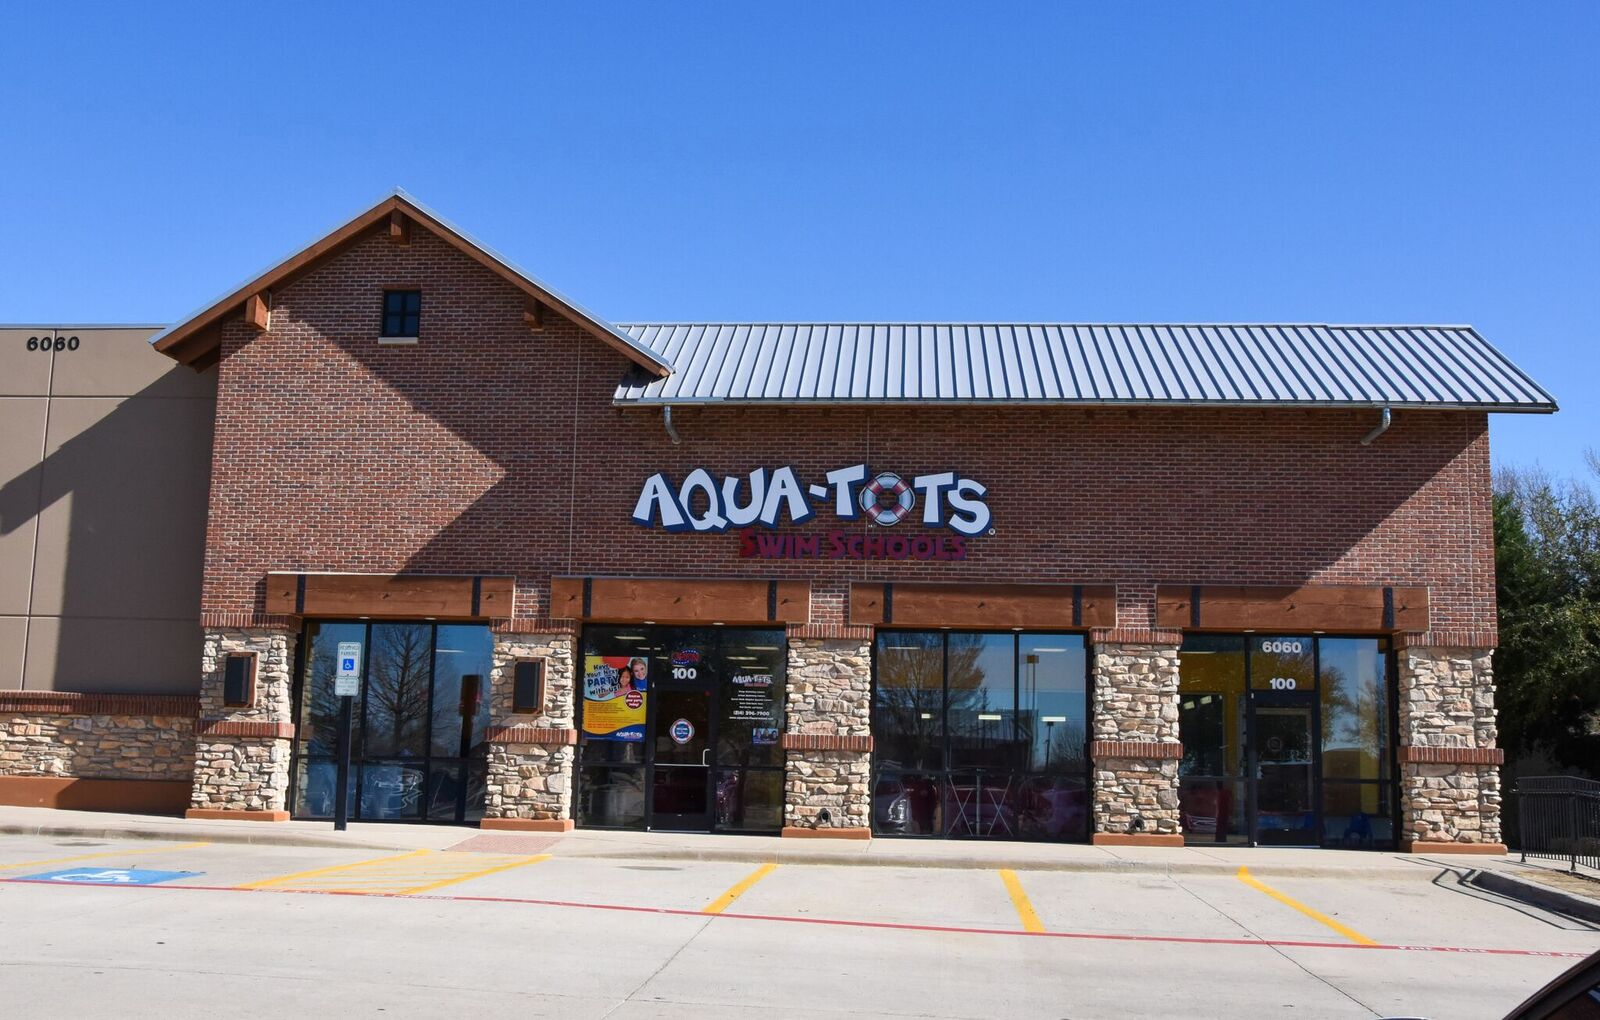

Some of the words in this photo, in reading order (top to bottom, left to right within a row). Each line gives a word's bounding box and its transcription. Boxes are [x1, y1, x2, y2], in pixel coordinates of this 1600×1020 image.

[26, 336, 80, 352] 6060
[632, 464, 992, 537] AQUA-TOTS
[1262, 641, 1302, 654] 6060
[672, 667, 697, 679] 100
[587, 675, 618, 687] PARTY
[1269, 678, 1296, 690] 100
